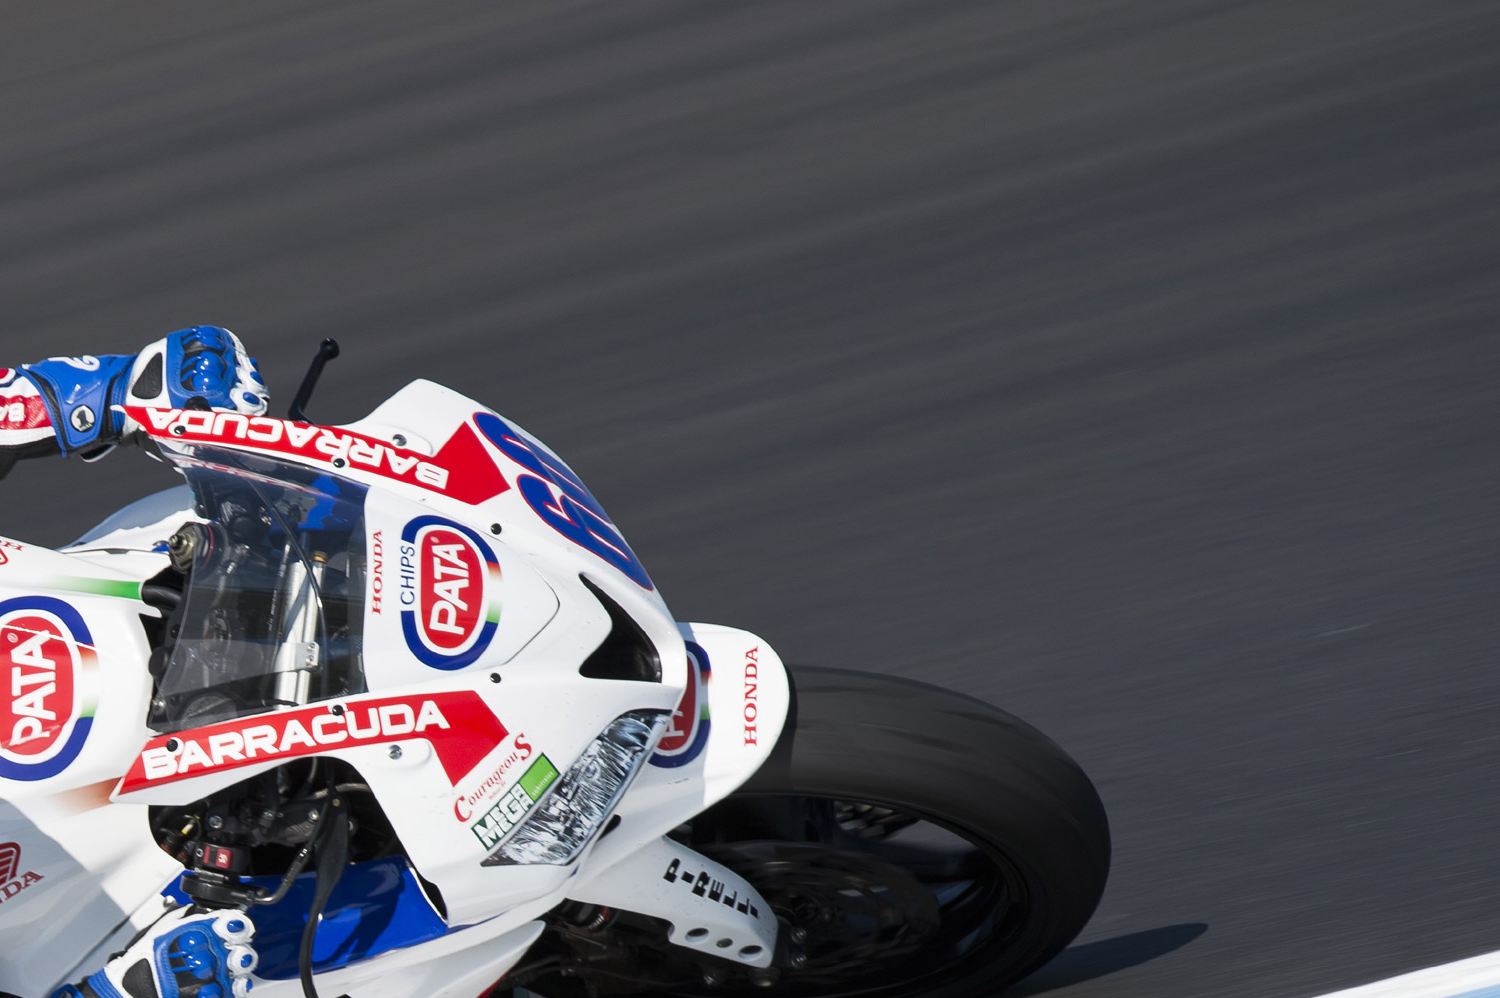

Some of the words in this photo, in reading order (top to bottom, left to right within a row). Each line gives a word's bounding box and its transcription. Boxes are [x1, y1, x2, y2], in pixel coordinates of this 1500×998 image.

[145, 407, 450, 490] BARRACUDA
[371, 530, 383, 615] HONDA
[400, 545, 415, 606] CHIPS
[429, 541, 470, 635] PATA
[11, 630, 59, 746] PATA
[744, 646, 759, 747] HONDA
[142, 700, 450, 780] BARRACUDA
